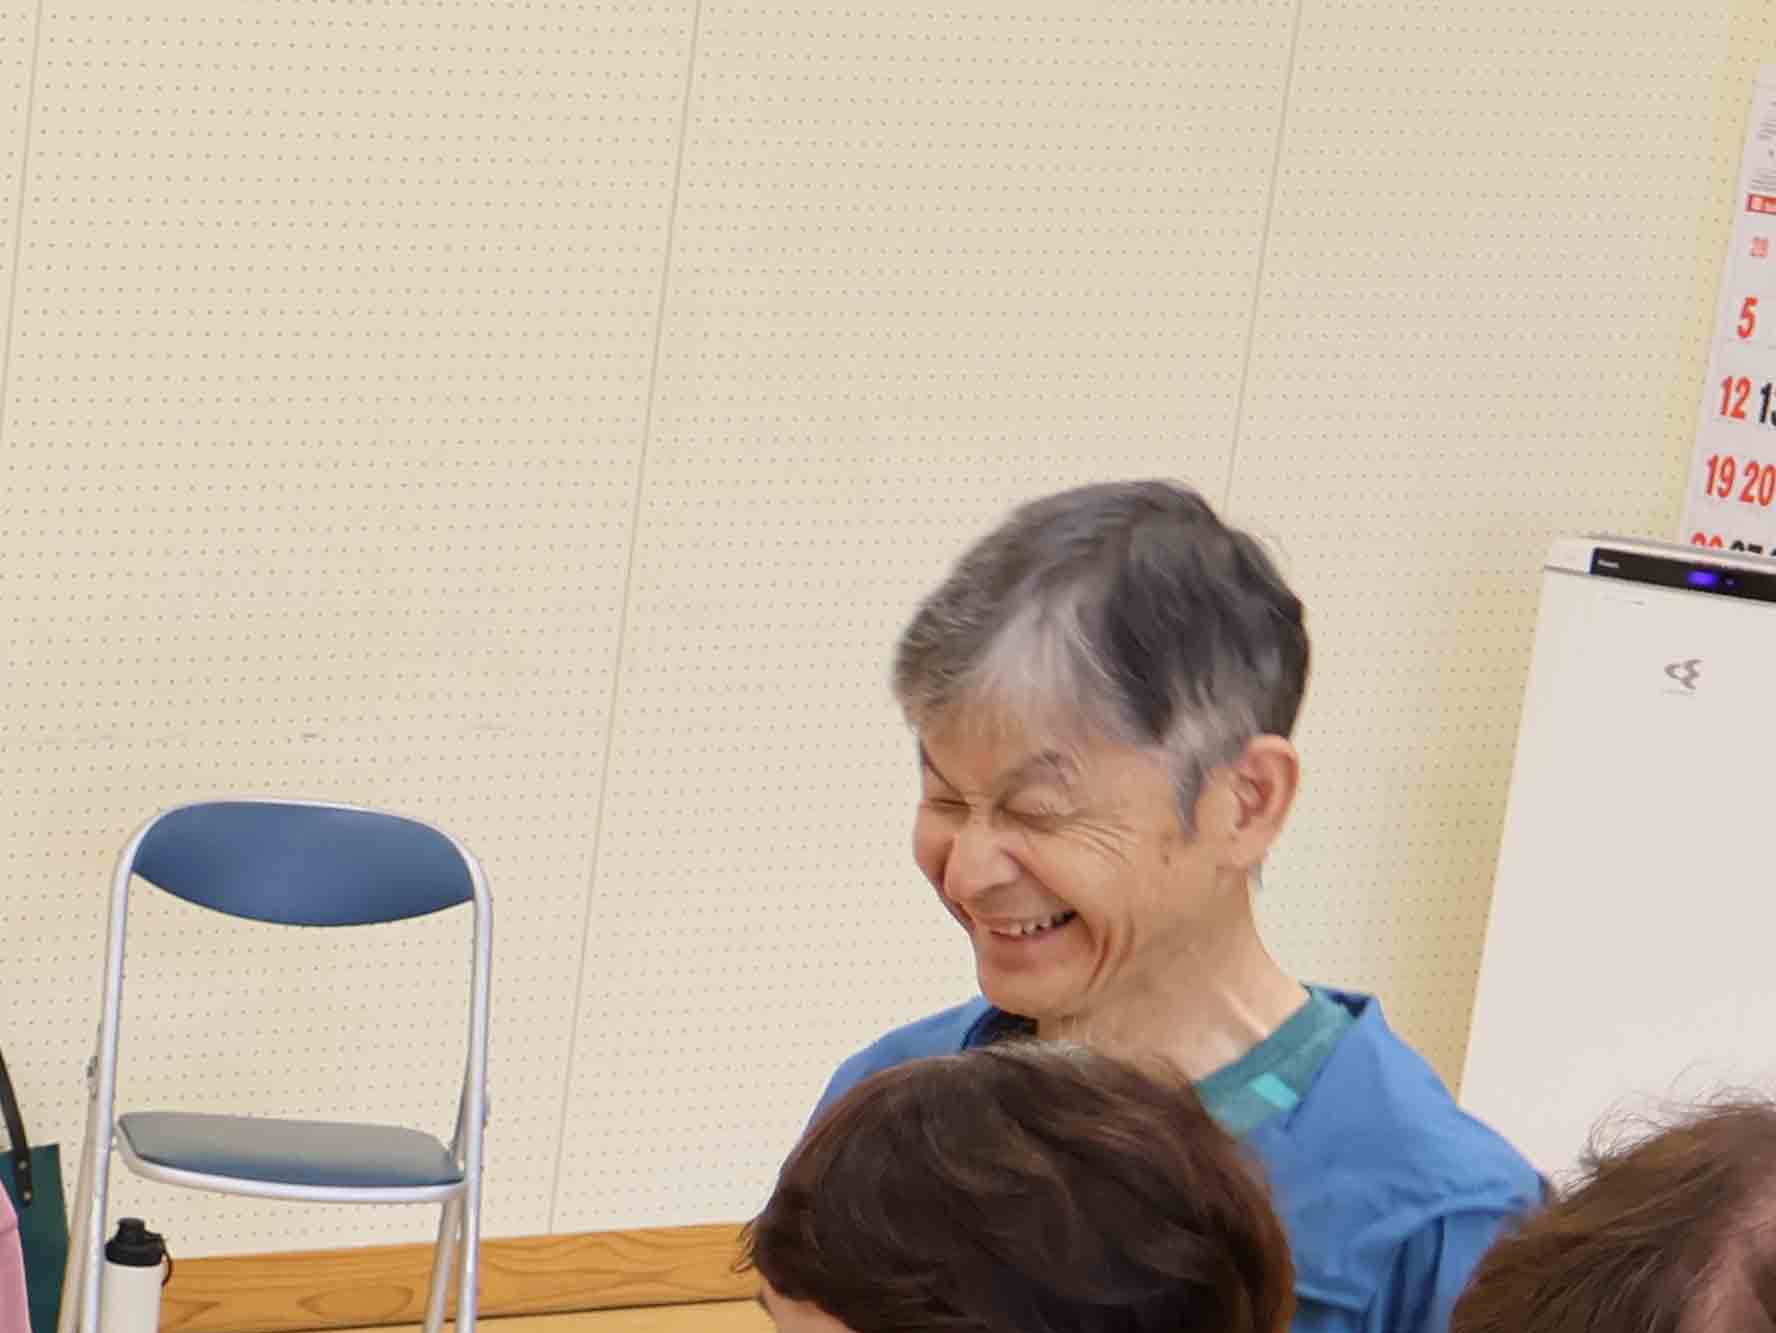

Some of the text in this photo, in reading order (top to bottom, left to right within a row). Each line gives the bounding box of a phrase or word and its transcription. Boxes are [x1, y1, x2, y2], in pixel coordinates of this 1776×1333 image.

[1737, 297, 1759, 339] 5
[1719, 376, 1776, 427] 12 1
[1705, 453, 1776, 507] 19 20
